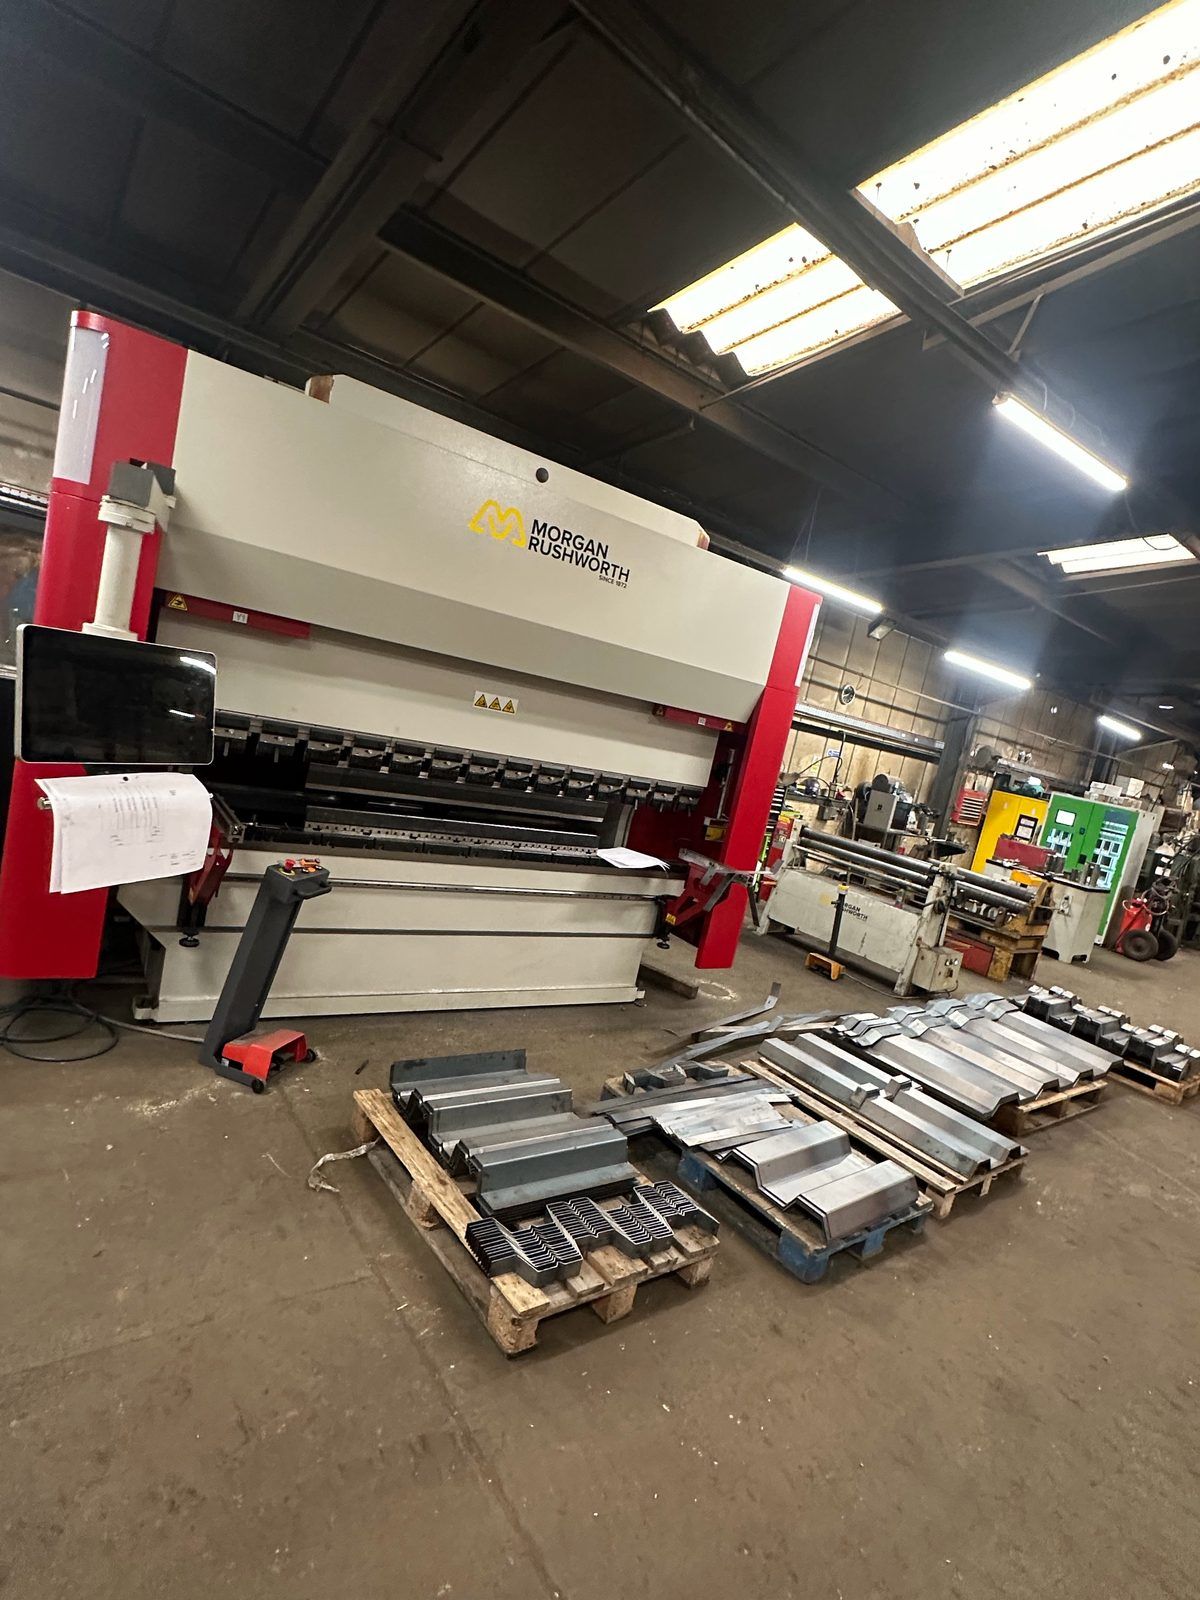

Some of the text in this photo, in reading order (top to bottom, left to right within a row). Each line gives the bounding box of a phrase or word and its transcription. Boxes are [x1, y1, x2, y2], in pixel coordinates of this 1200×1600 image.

[528, 536, 630, 582] RUSHWORTH
[531, 519, 609, 559] MORGAN
[599, 574, 614, 584] SINCE
